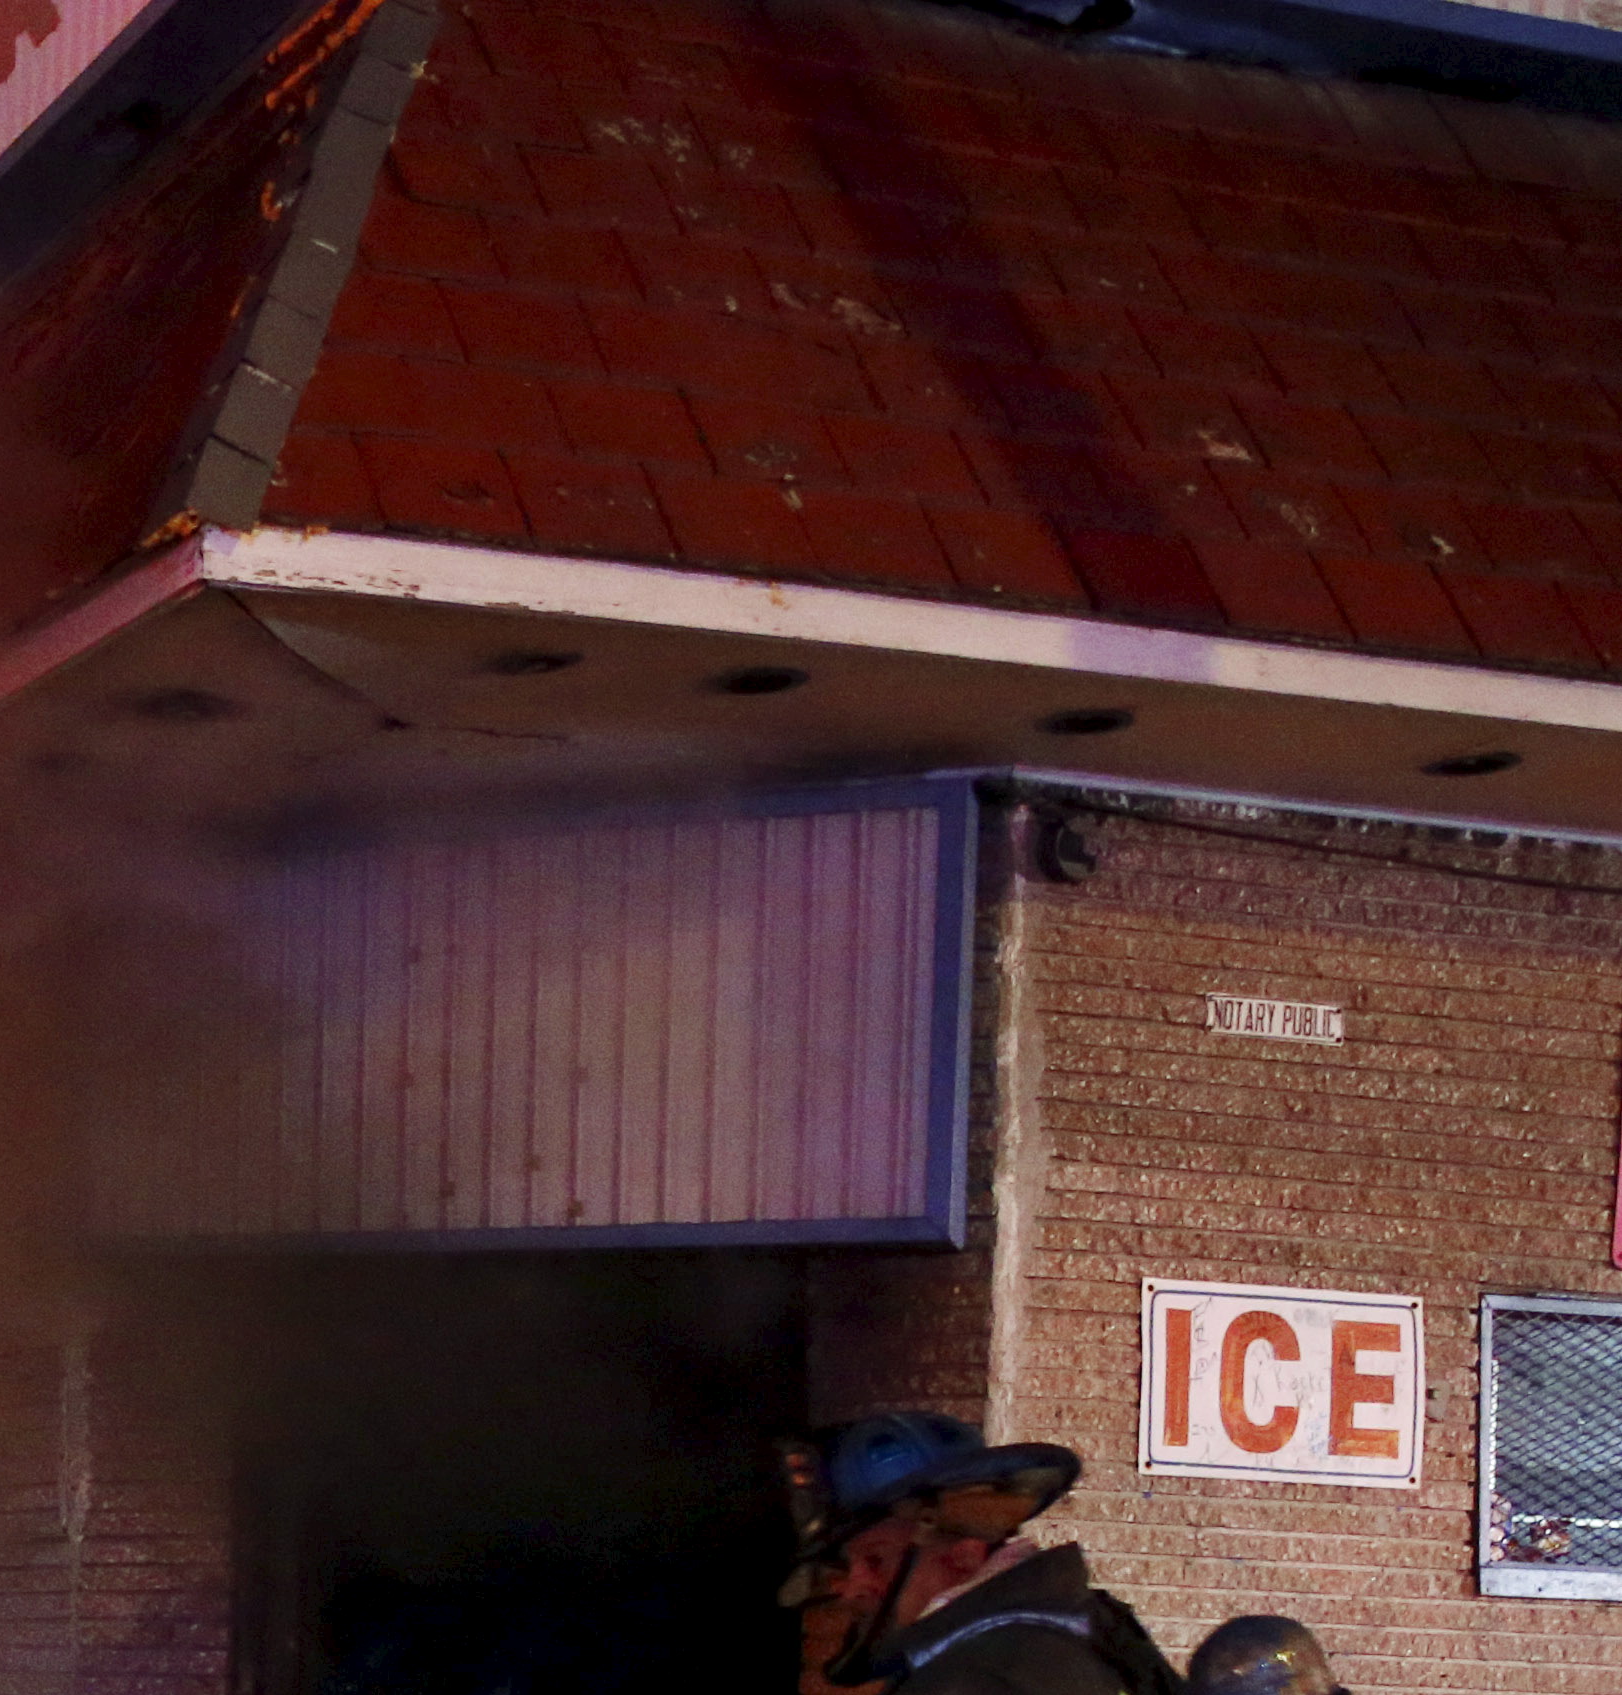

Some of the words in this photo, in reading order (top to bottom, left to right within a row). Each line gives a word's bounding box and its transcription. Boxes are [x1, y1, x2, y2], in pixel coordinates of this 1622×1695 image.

[1214, 1000, 1276, 1033] NOTARY
[1282, 1005, 1336, 1038] PUBLIC
[1162, 1308, 1402, 1459] ICE
